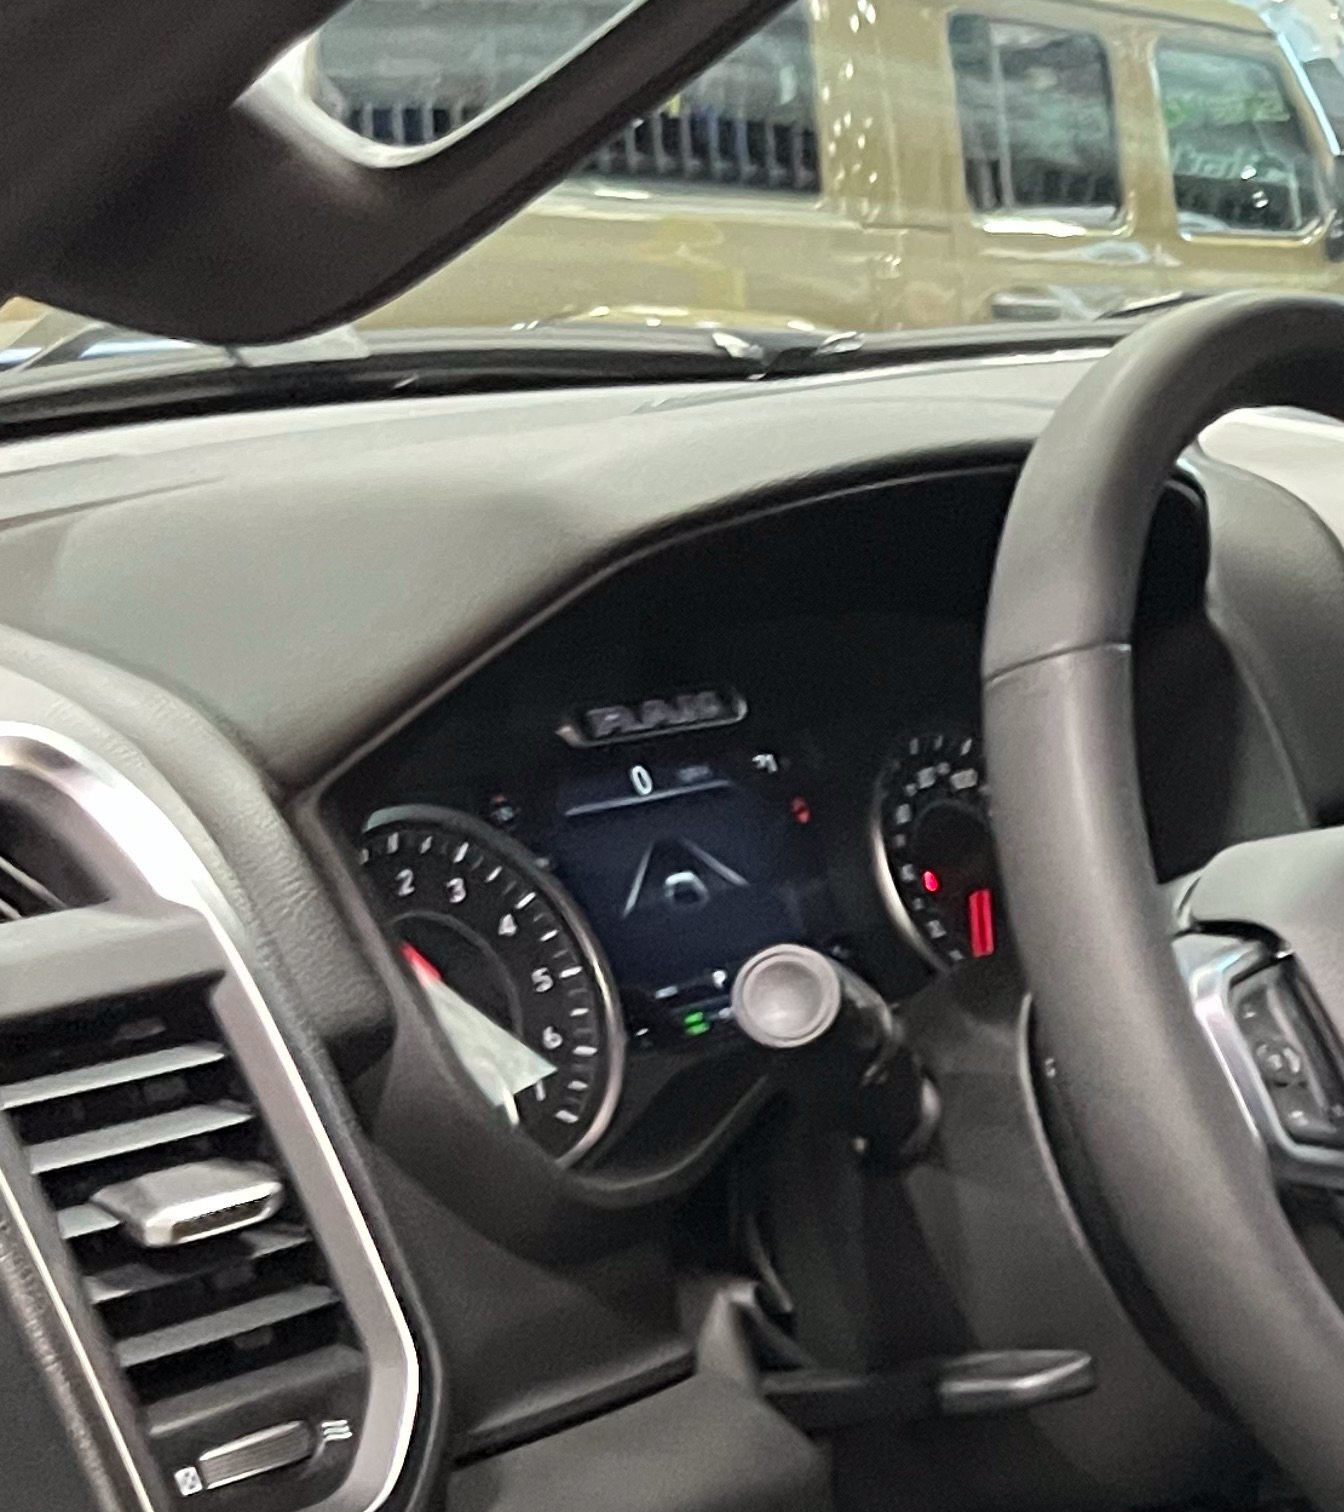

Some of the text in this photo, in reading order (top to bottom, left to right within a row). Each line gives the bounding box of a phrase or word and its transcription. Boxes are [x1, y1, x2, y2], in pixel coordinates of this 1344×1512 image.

[630, 765, 653, 796] 0
[394, 868, 416, 897] 2
[446, 877, 467, 904] 3
[497, 912, 518, 937] 4
[530, 966, 554, 994] 5
[541, 1025, 563, 1051] 6
